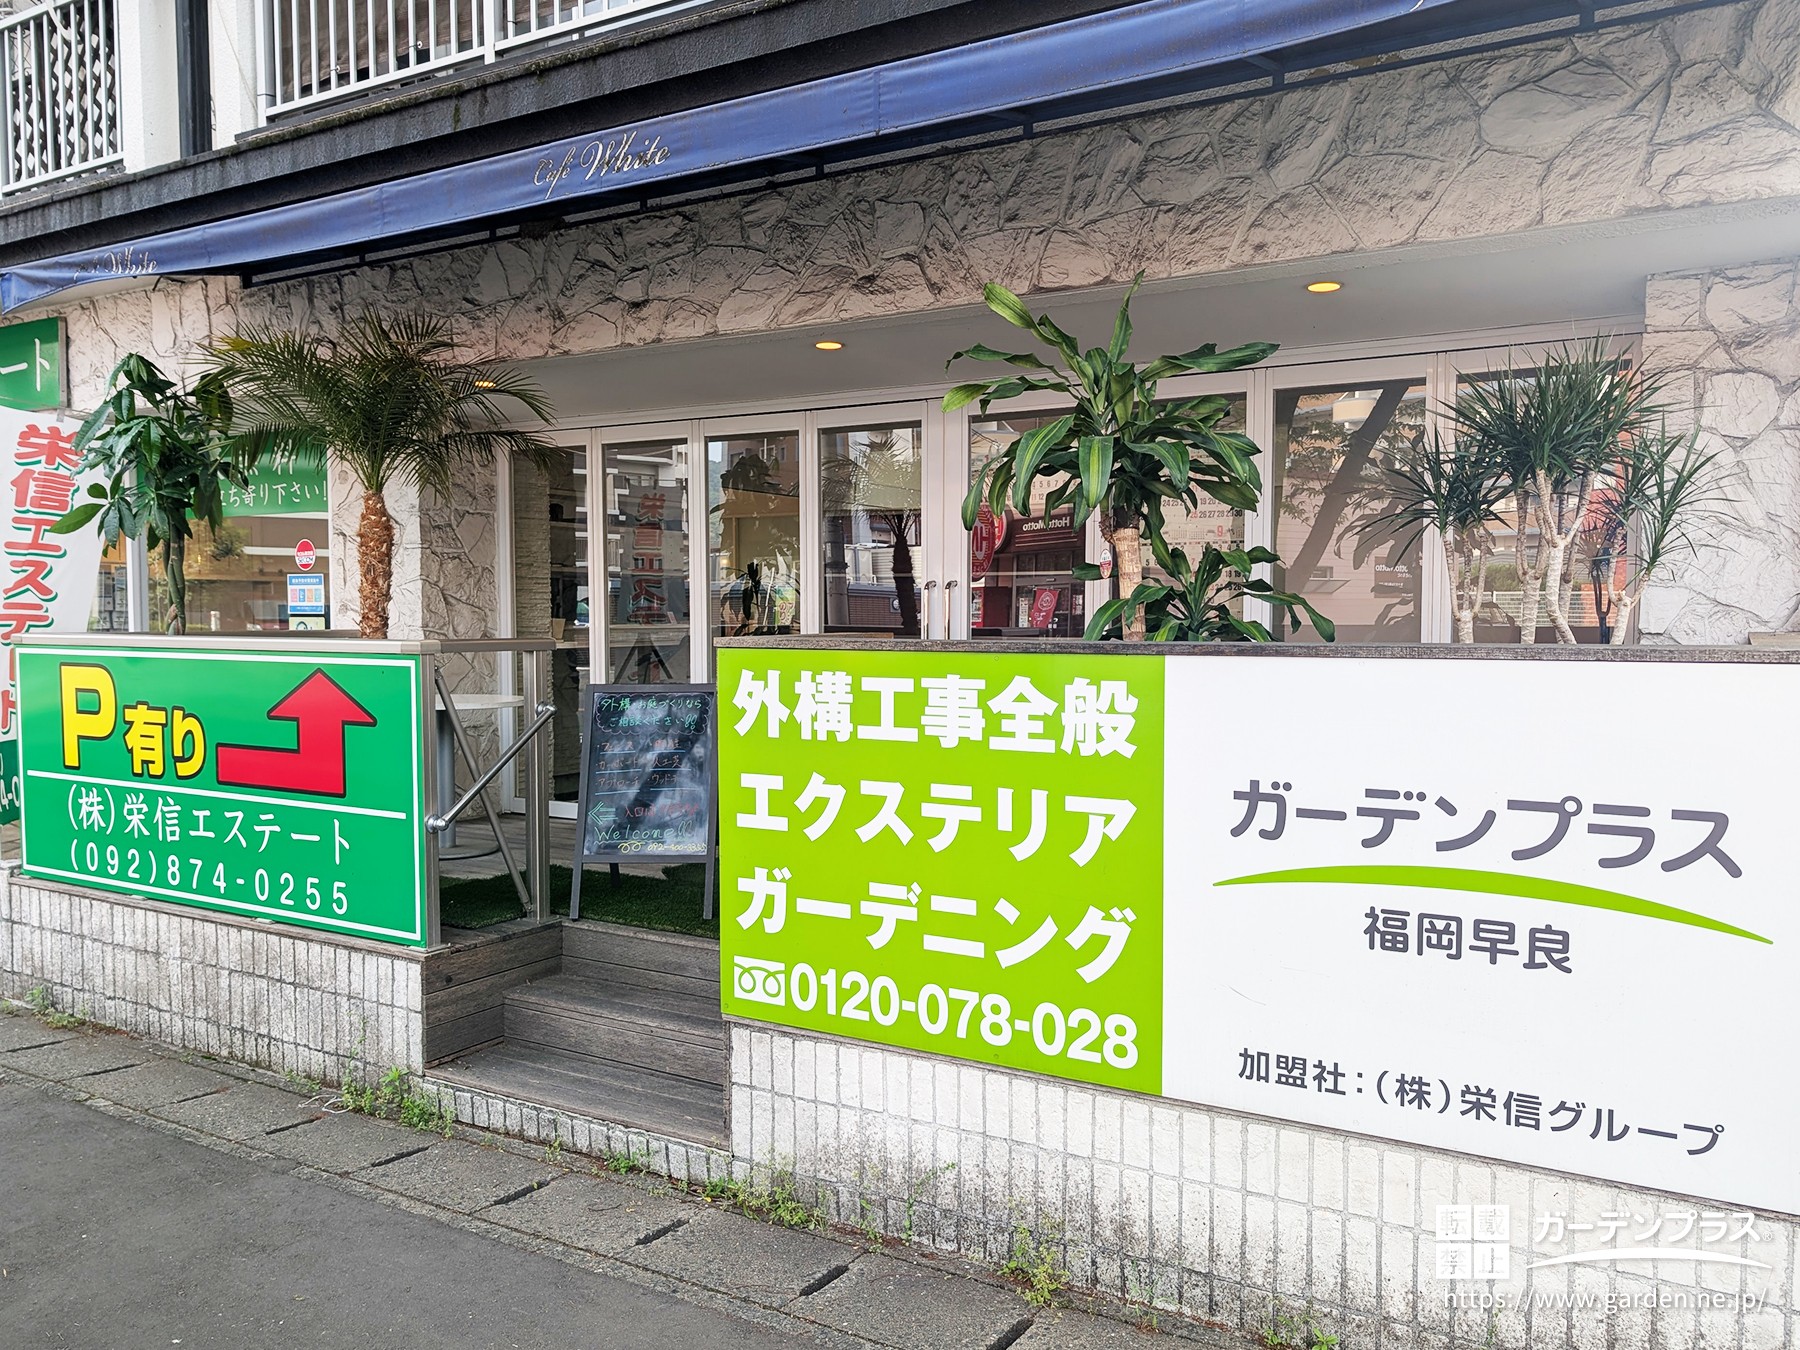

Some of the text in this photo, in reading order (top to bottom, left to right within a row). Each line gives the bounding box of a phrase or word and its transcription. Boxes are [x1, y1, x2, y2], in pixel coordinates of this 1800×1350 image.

[580, 130, 671, 181] White
[103, 246, 158, 275] White
[733, 669, 1139, 759] 外構工事全般
[68, 784, 350, 865] (株)栄信エステート
[736, 772, 1137, 867] エクステリア
[1230, 780, 1742, 878] ガーデンプラス
[71, 839, 348, 915] (092)874-0255
[736, 866, 1137, 984] ガーデニング
[1364, 906, 1572, 974] 福岡早良
[790, 962, 1138, 1069] 0120-078-028
